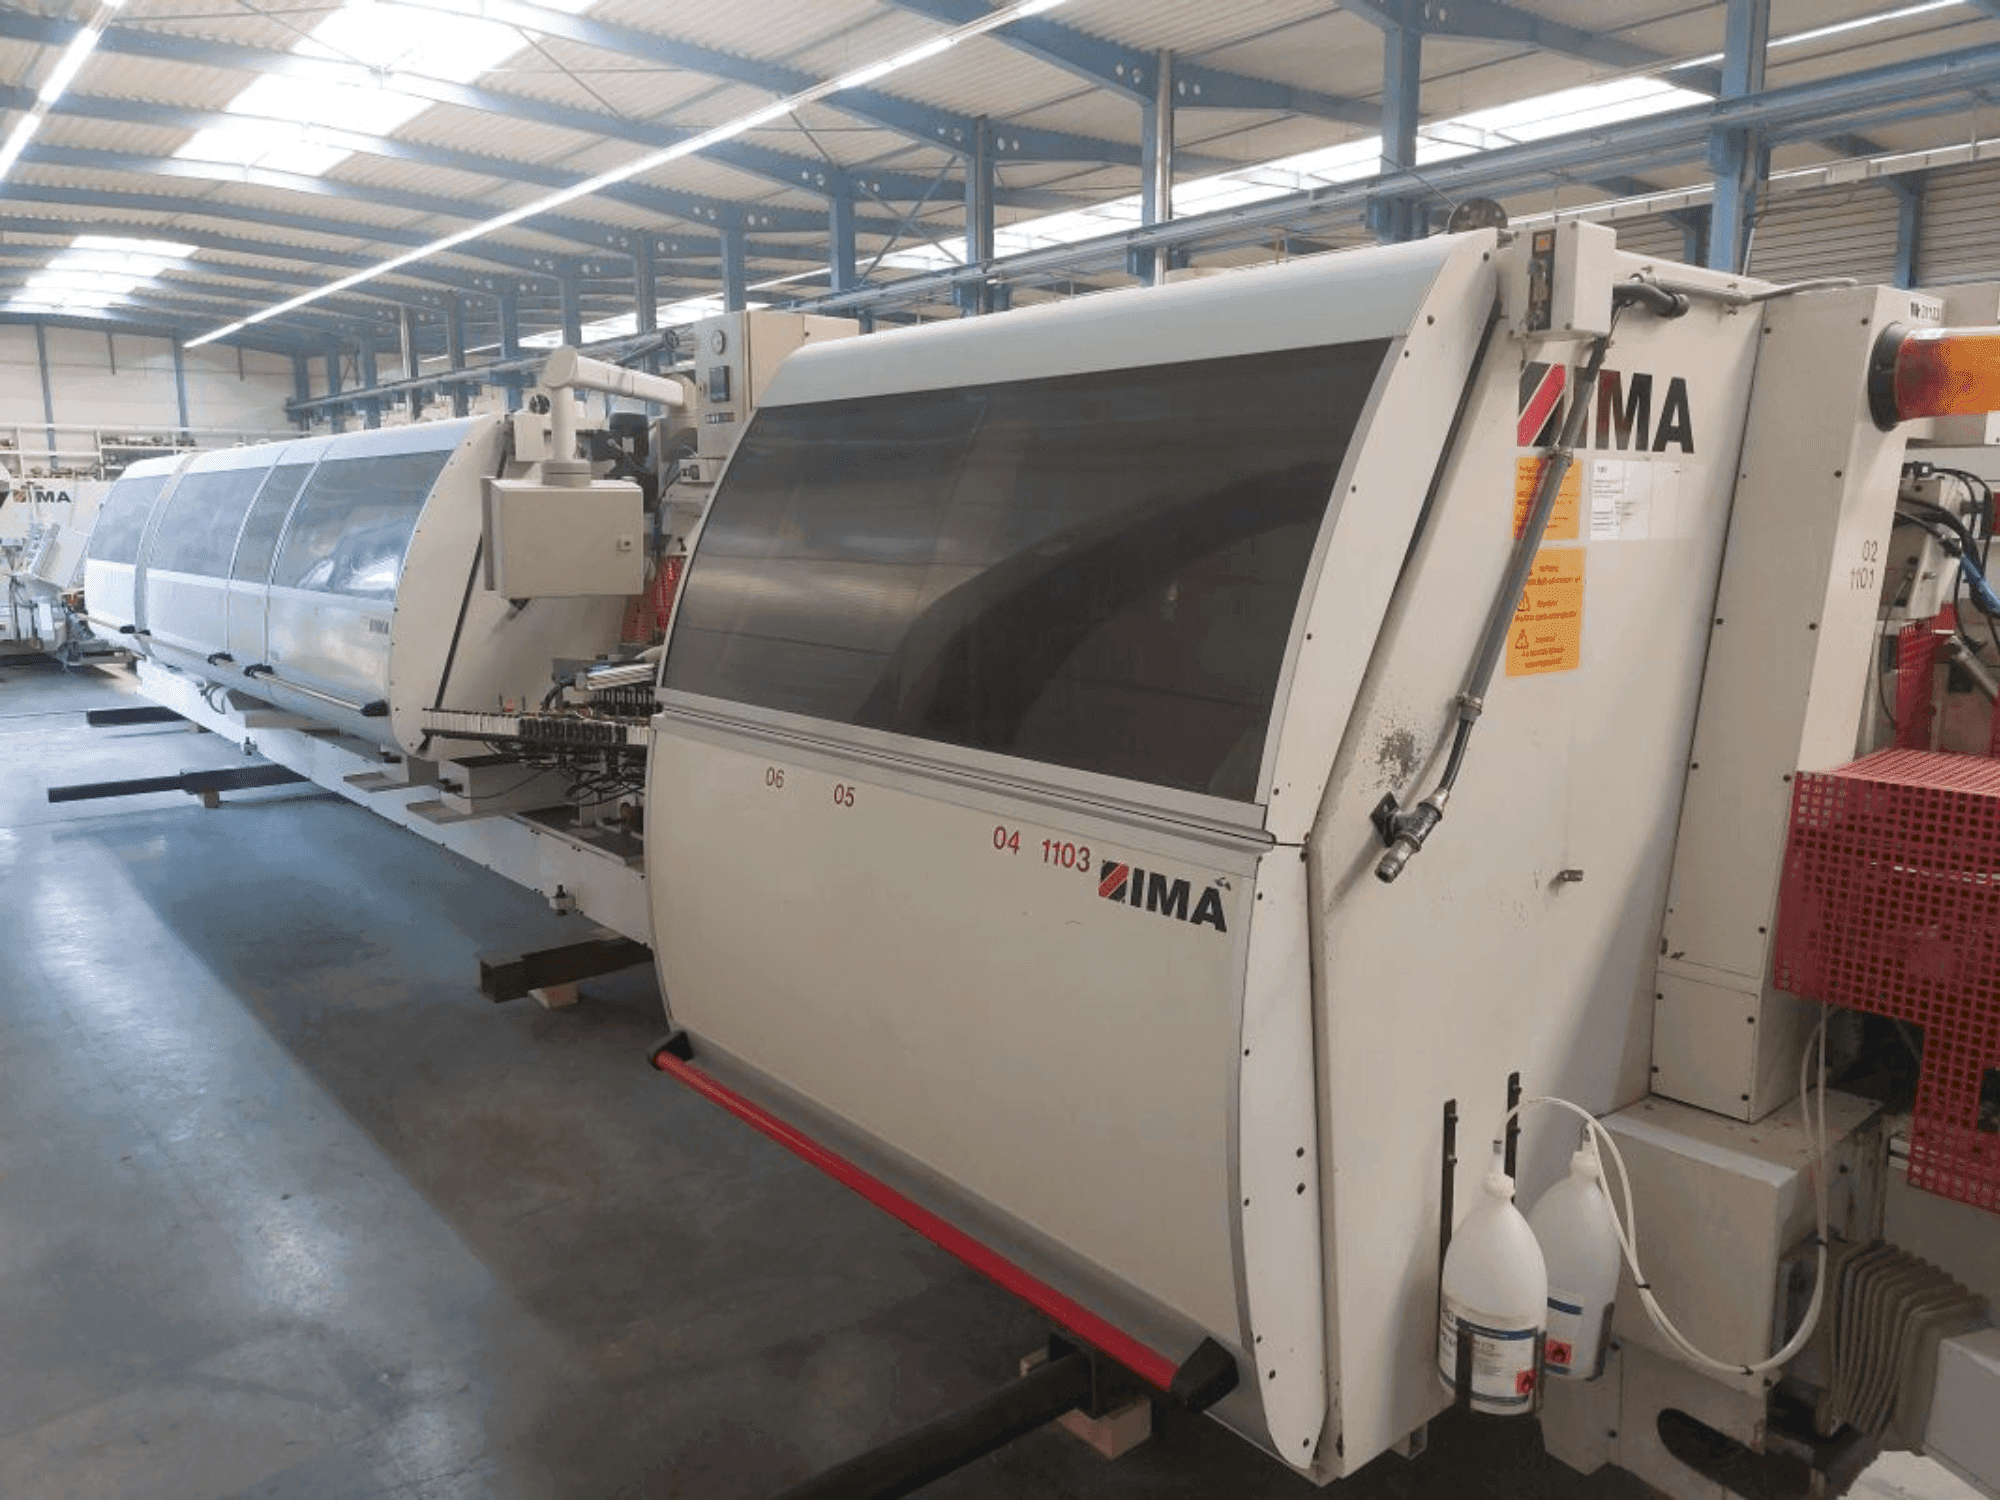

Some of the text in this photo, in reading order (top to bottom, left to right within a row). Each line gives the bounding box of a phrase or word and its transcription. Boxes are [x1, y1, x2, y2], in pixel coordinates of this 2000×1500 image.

[1862, 540, 1877, 563] 02
[1850, 567, 1874, 590] 1101
[766, 766, 785, 788] 06
[833, 784, 856, 807] 05
[993, 826, 1091, 872] 04 1103
[1130, 867, 1227, 933] IMA
